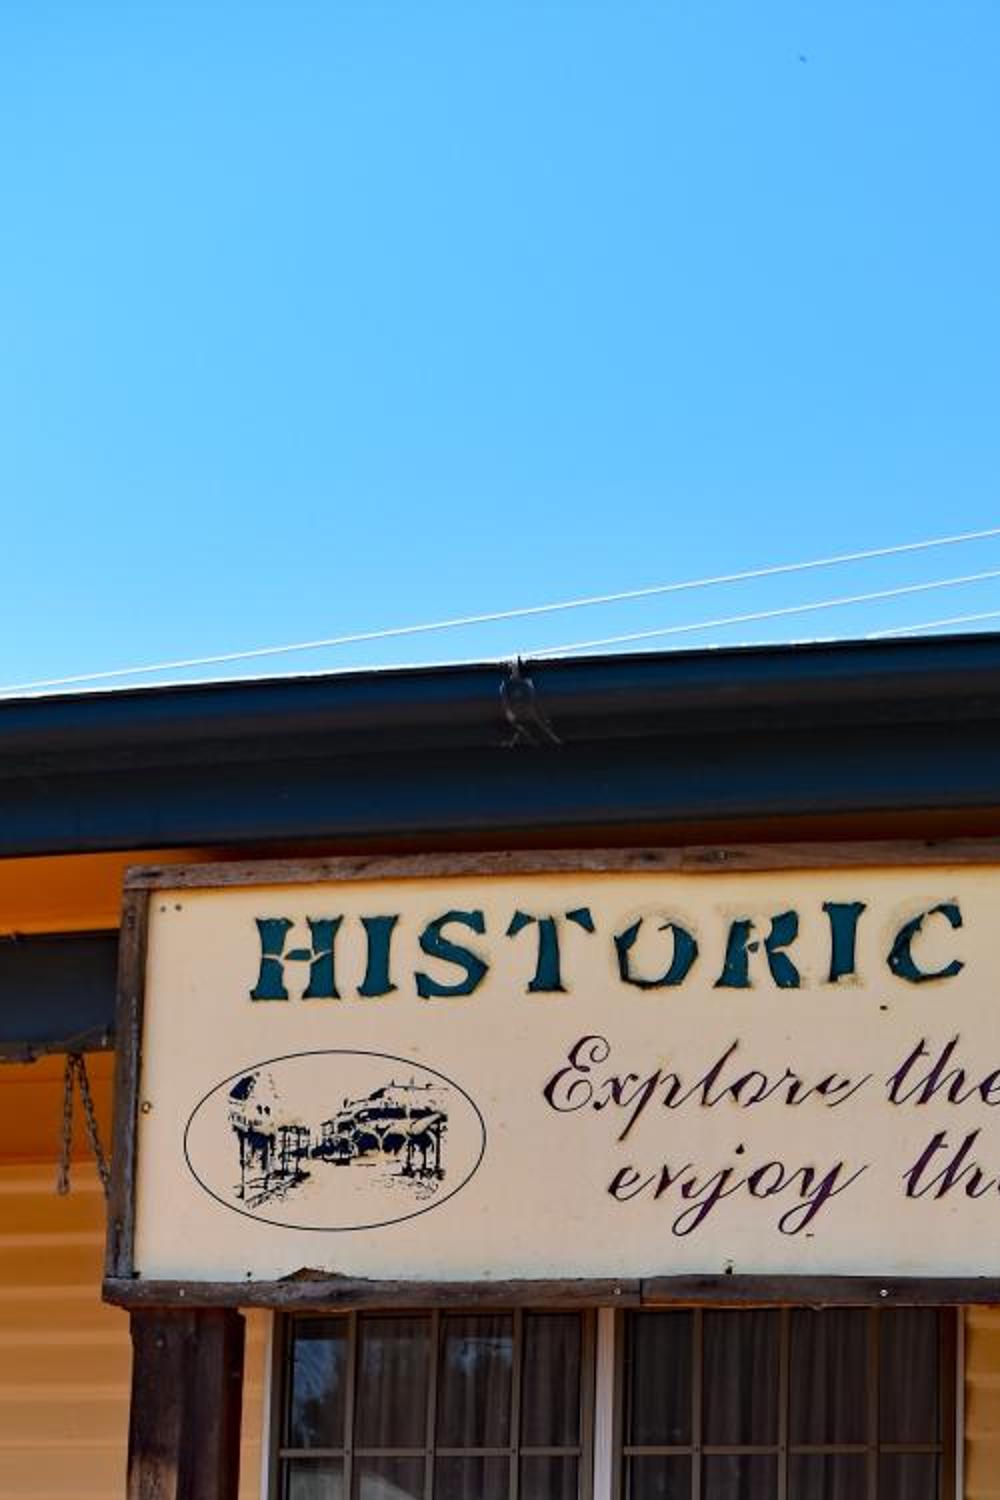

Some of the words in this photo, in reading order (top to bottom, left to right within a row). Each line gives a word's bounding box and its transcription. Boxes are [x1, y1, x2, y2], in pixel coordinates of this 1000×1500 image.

[249, 900, 965, 1001] HISTORIC
[542, 1034, 874, 1142] Explore
[607, 1143, 869, 1237] enjoy
